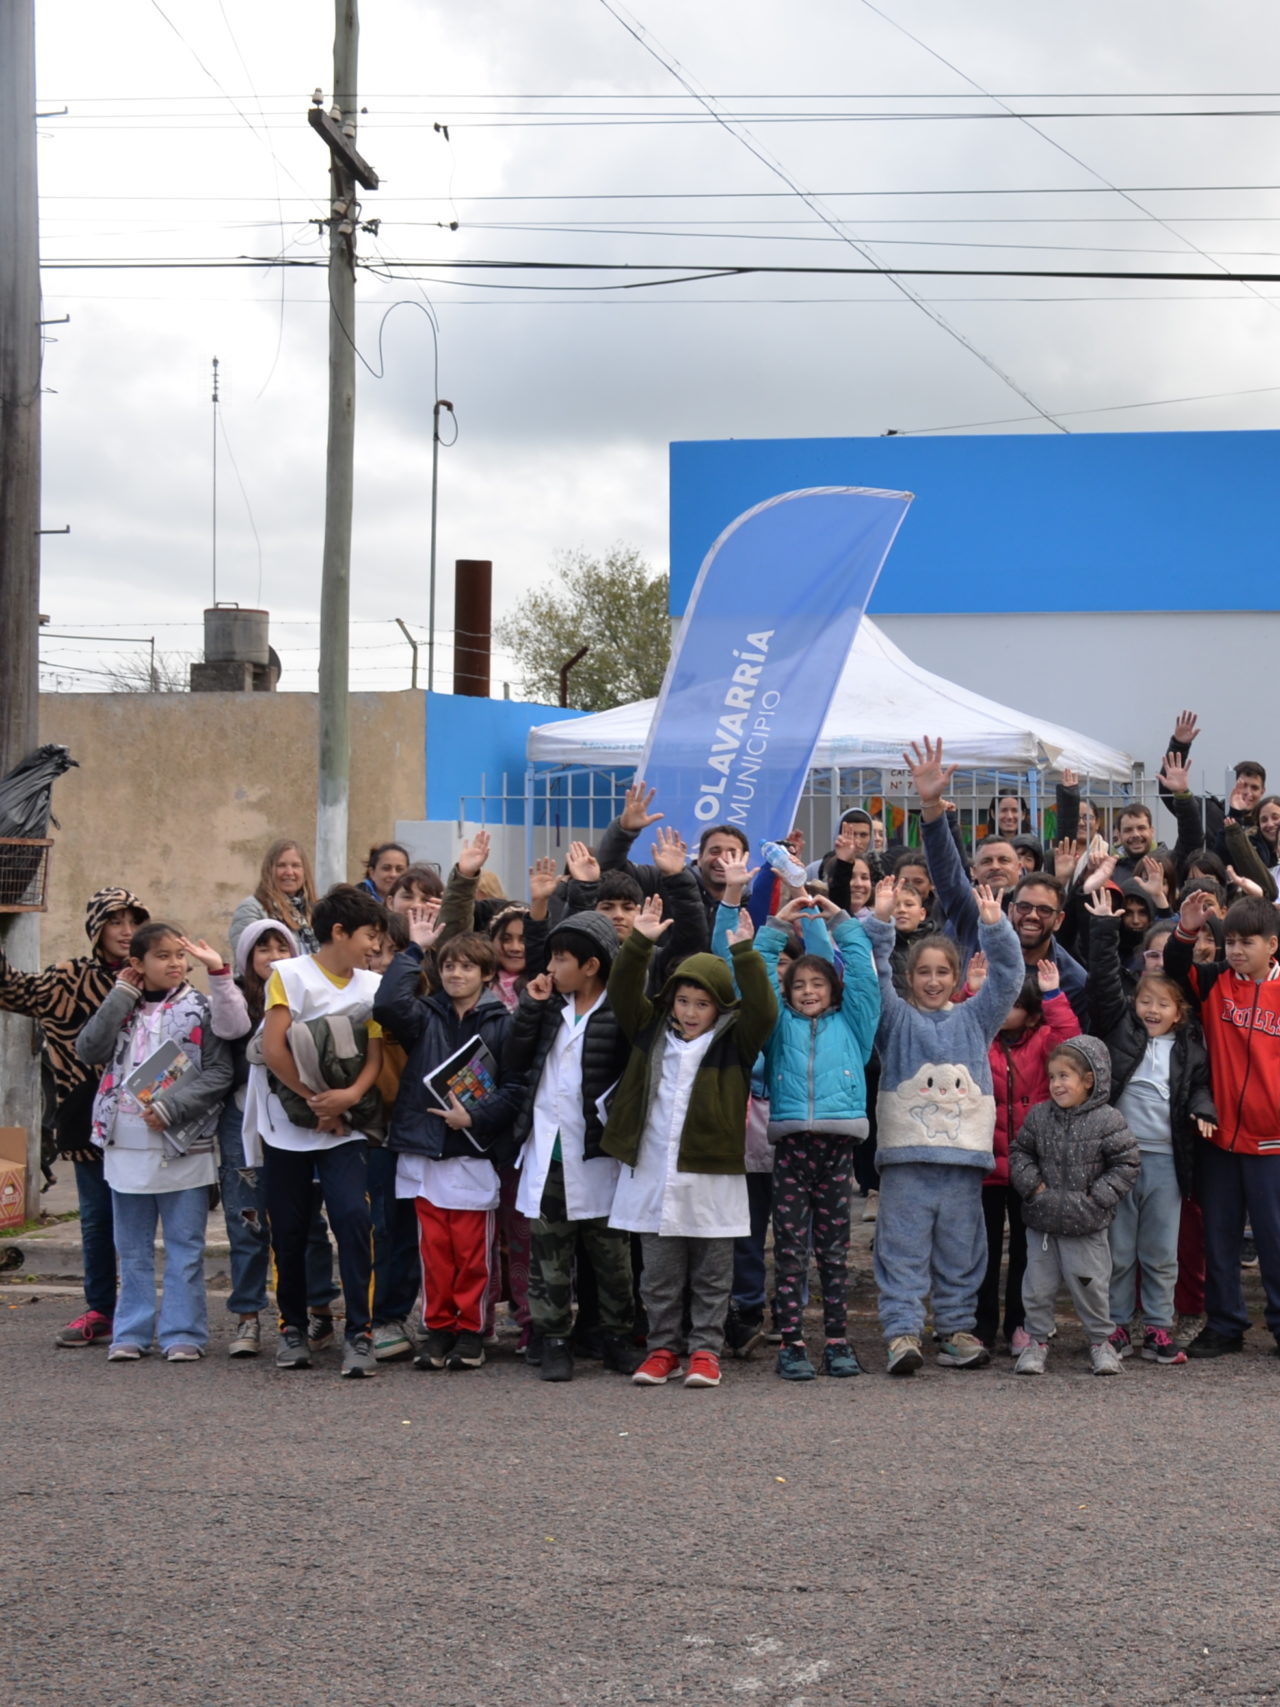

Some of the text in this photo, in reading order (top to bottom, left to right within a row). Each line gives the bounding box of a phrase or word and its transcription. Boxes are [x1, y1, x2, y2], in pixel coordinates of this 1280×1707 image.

[694, 630, 775, 821] OLAVARRÍA
[727, 690, 781, 826] MUNICIPIO
[907, 781, 913, 790] 7
